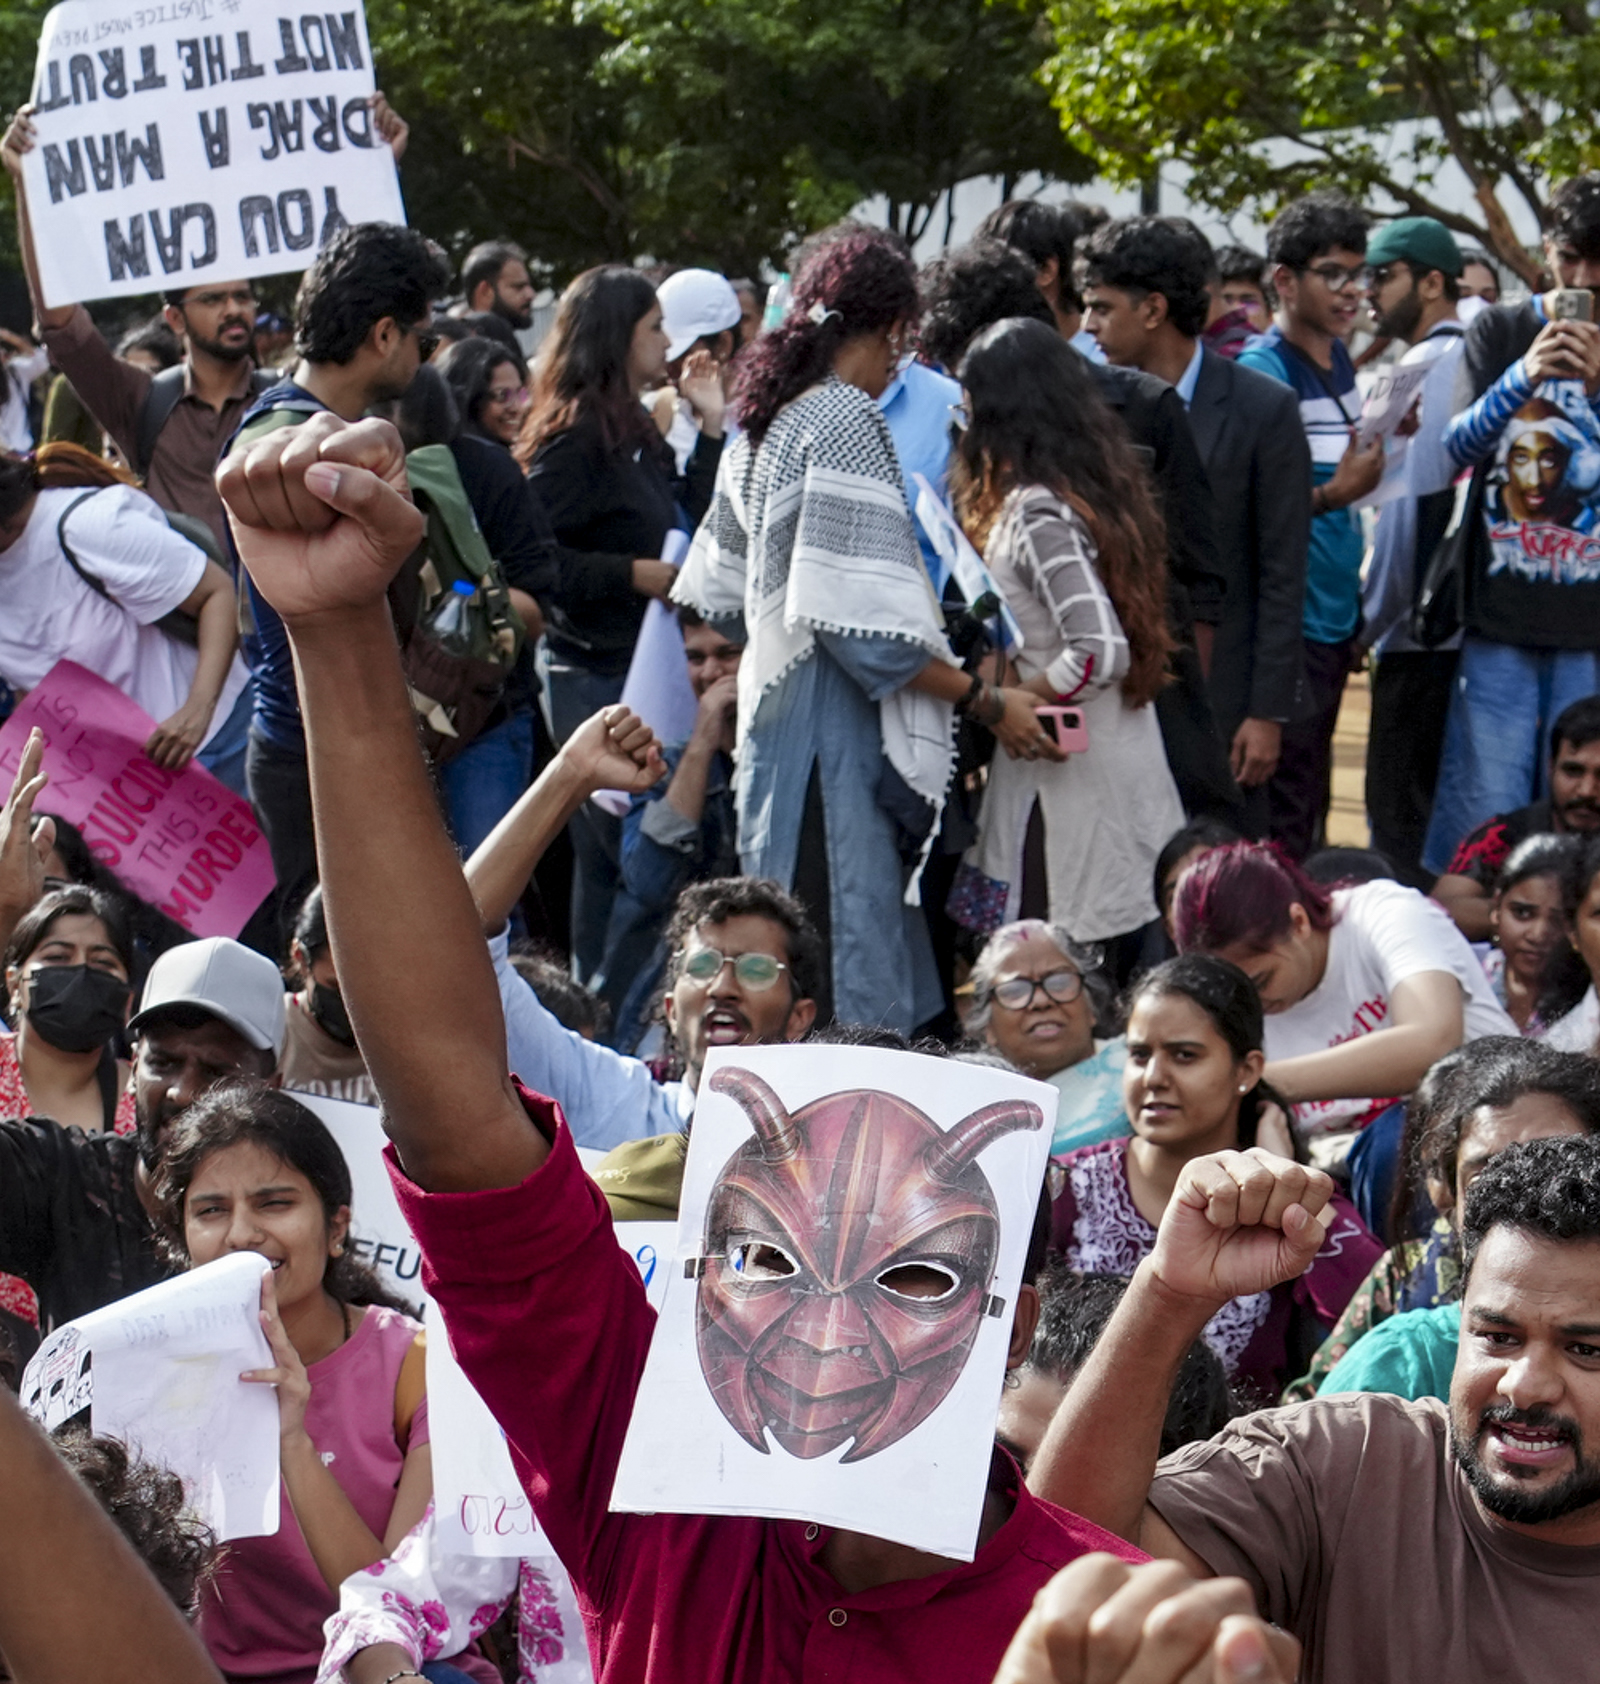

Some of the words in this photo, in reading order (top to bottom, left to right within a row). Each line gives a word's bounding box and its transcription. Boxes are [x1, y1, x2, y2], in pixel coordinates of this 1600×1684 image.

[177, 30, 264, 91] THE
[275, 11, 365, 73] NOT
[198, 106, 229, 170] A
[247, 95, 380, 161] DRAG
[43, 122, 164, 204] MAN
[103, 202, 218, 282] CAN
[239, 186, 349, 259] YOU
[52, 730, 96, 799] NOT
[77, 756, 187, 868] SUICID
[137, 811, 199, 871] THIS
